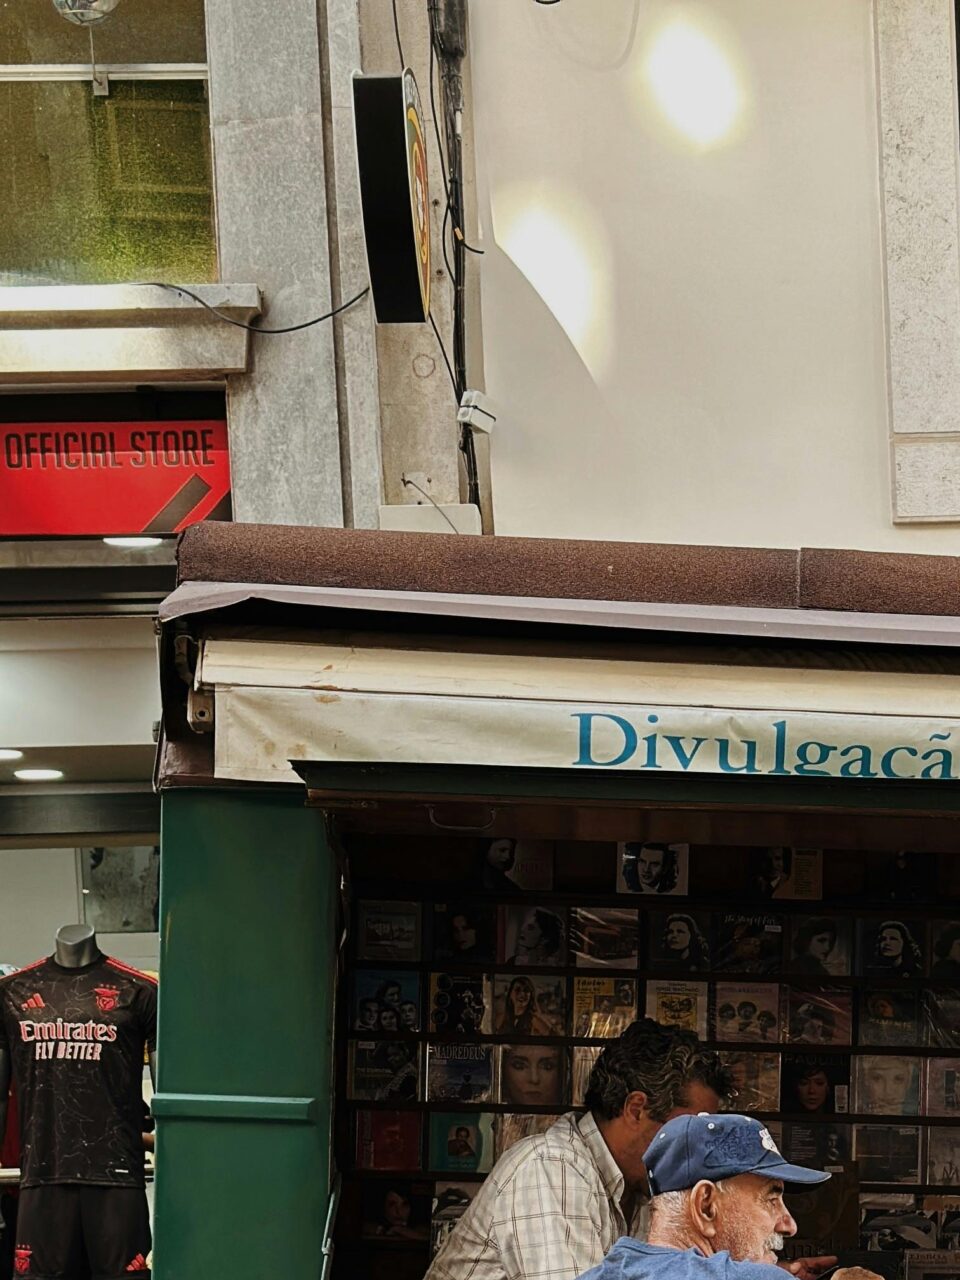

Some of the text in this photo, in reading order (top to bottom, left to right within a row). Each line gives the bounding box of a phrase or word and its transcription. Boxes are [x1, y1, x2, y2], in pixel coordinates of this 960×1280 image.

[5, 429, 215, 469] OFFICIAL STORE
[19, 1018, 117, 1042] Emirates
[35, 1042, 102, 1060] FLY BETTER
